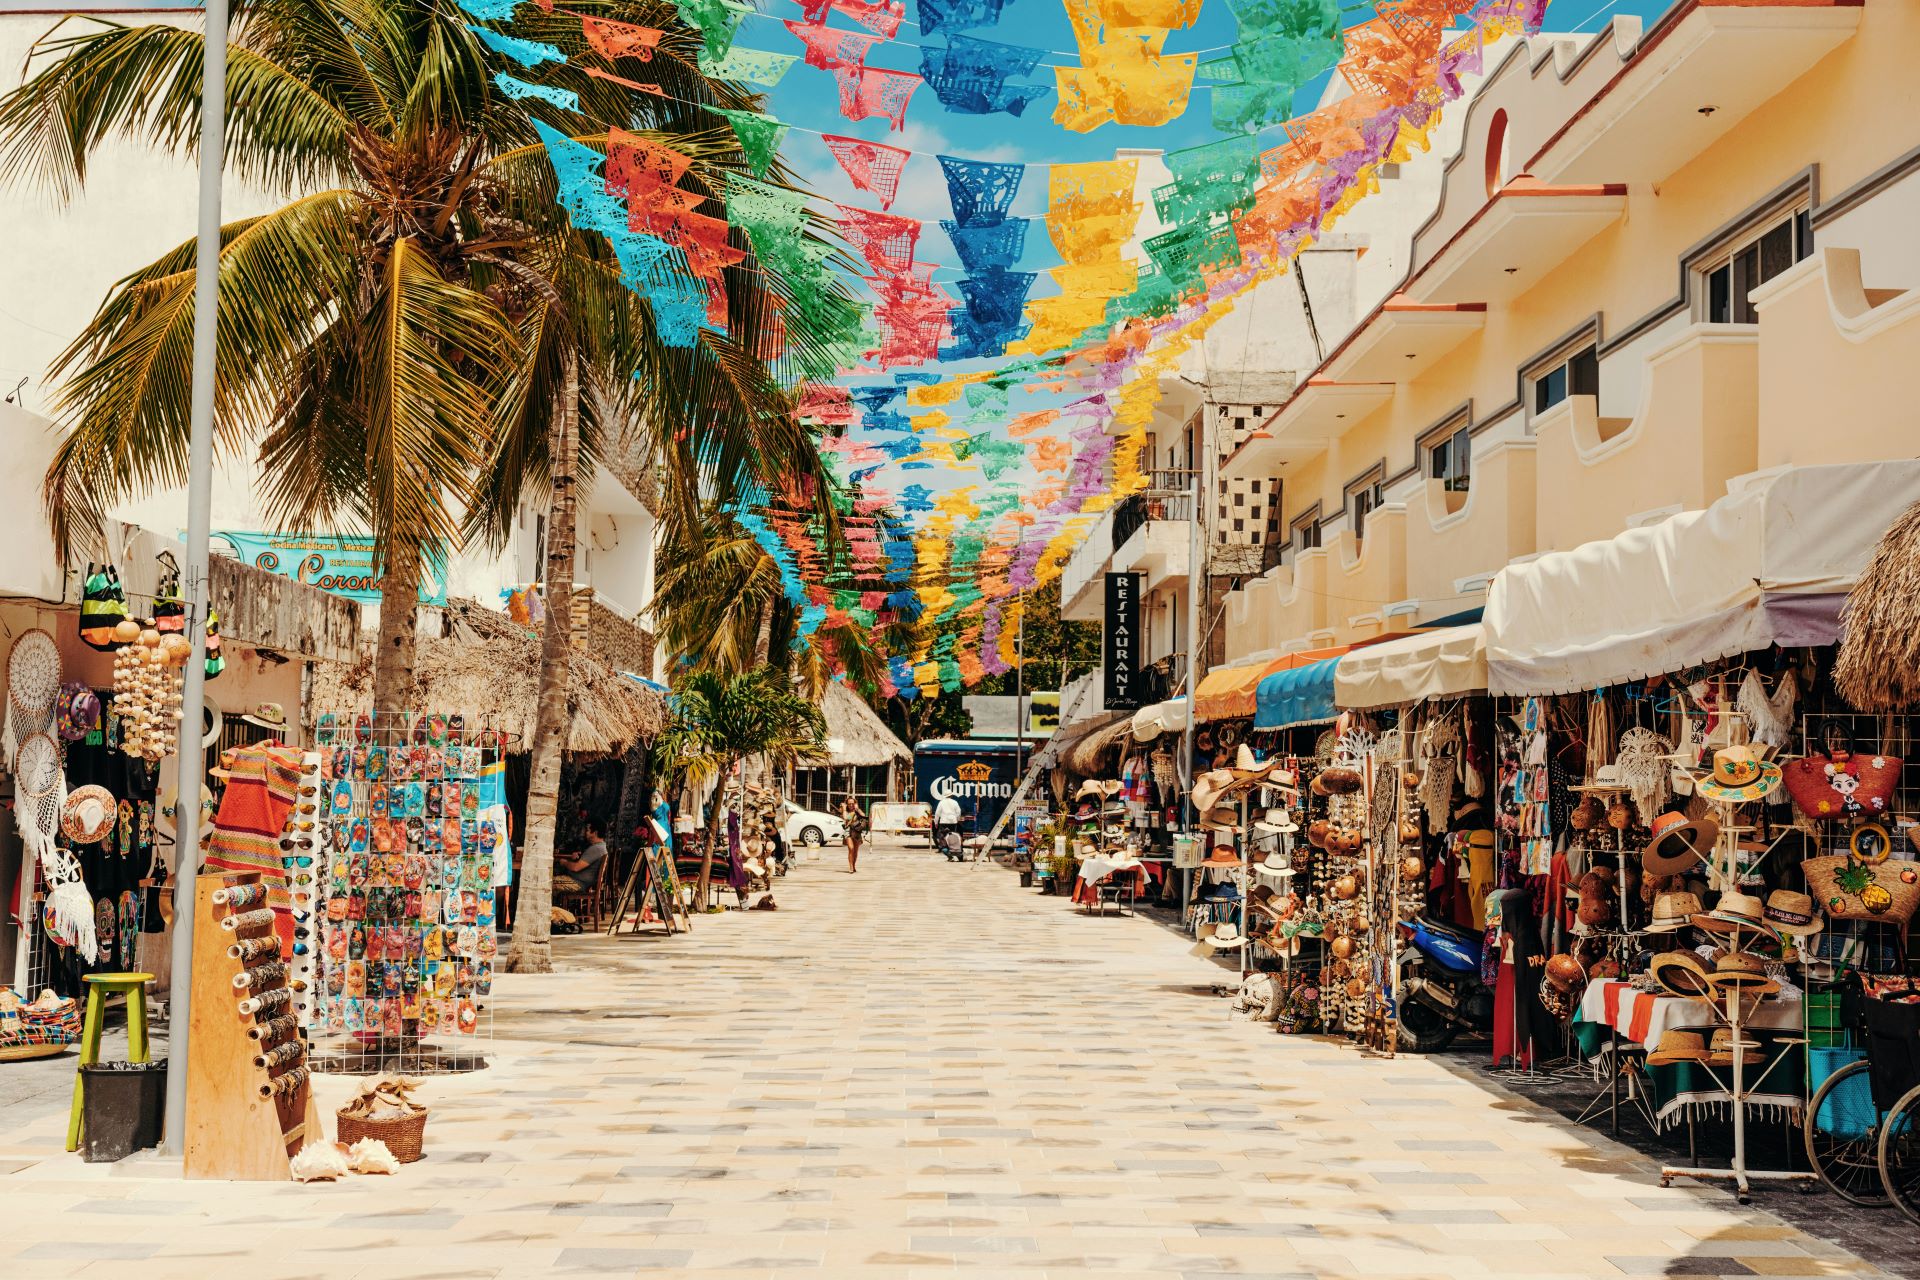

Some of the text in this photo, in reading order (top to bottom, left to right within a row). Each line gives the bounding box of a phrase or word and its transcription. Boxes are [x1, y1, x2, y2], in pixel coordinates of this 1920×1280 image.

[270, 540, 297, 550] Cocina
[298, 542, 336, 551] Mexicana
[1115, 577, 1129, 695] RESTAURANT
[930, 775, 1012, 801] Corona
